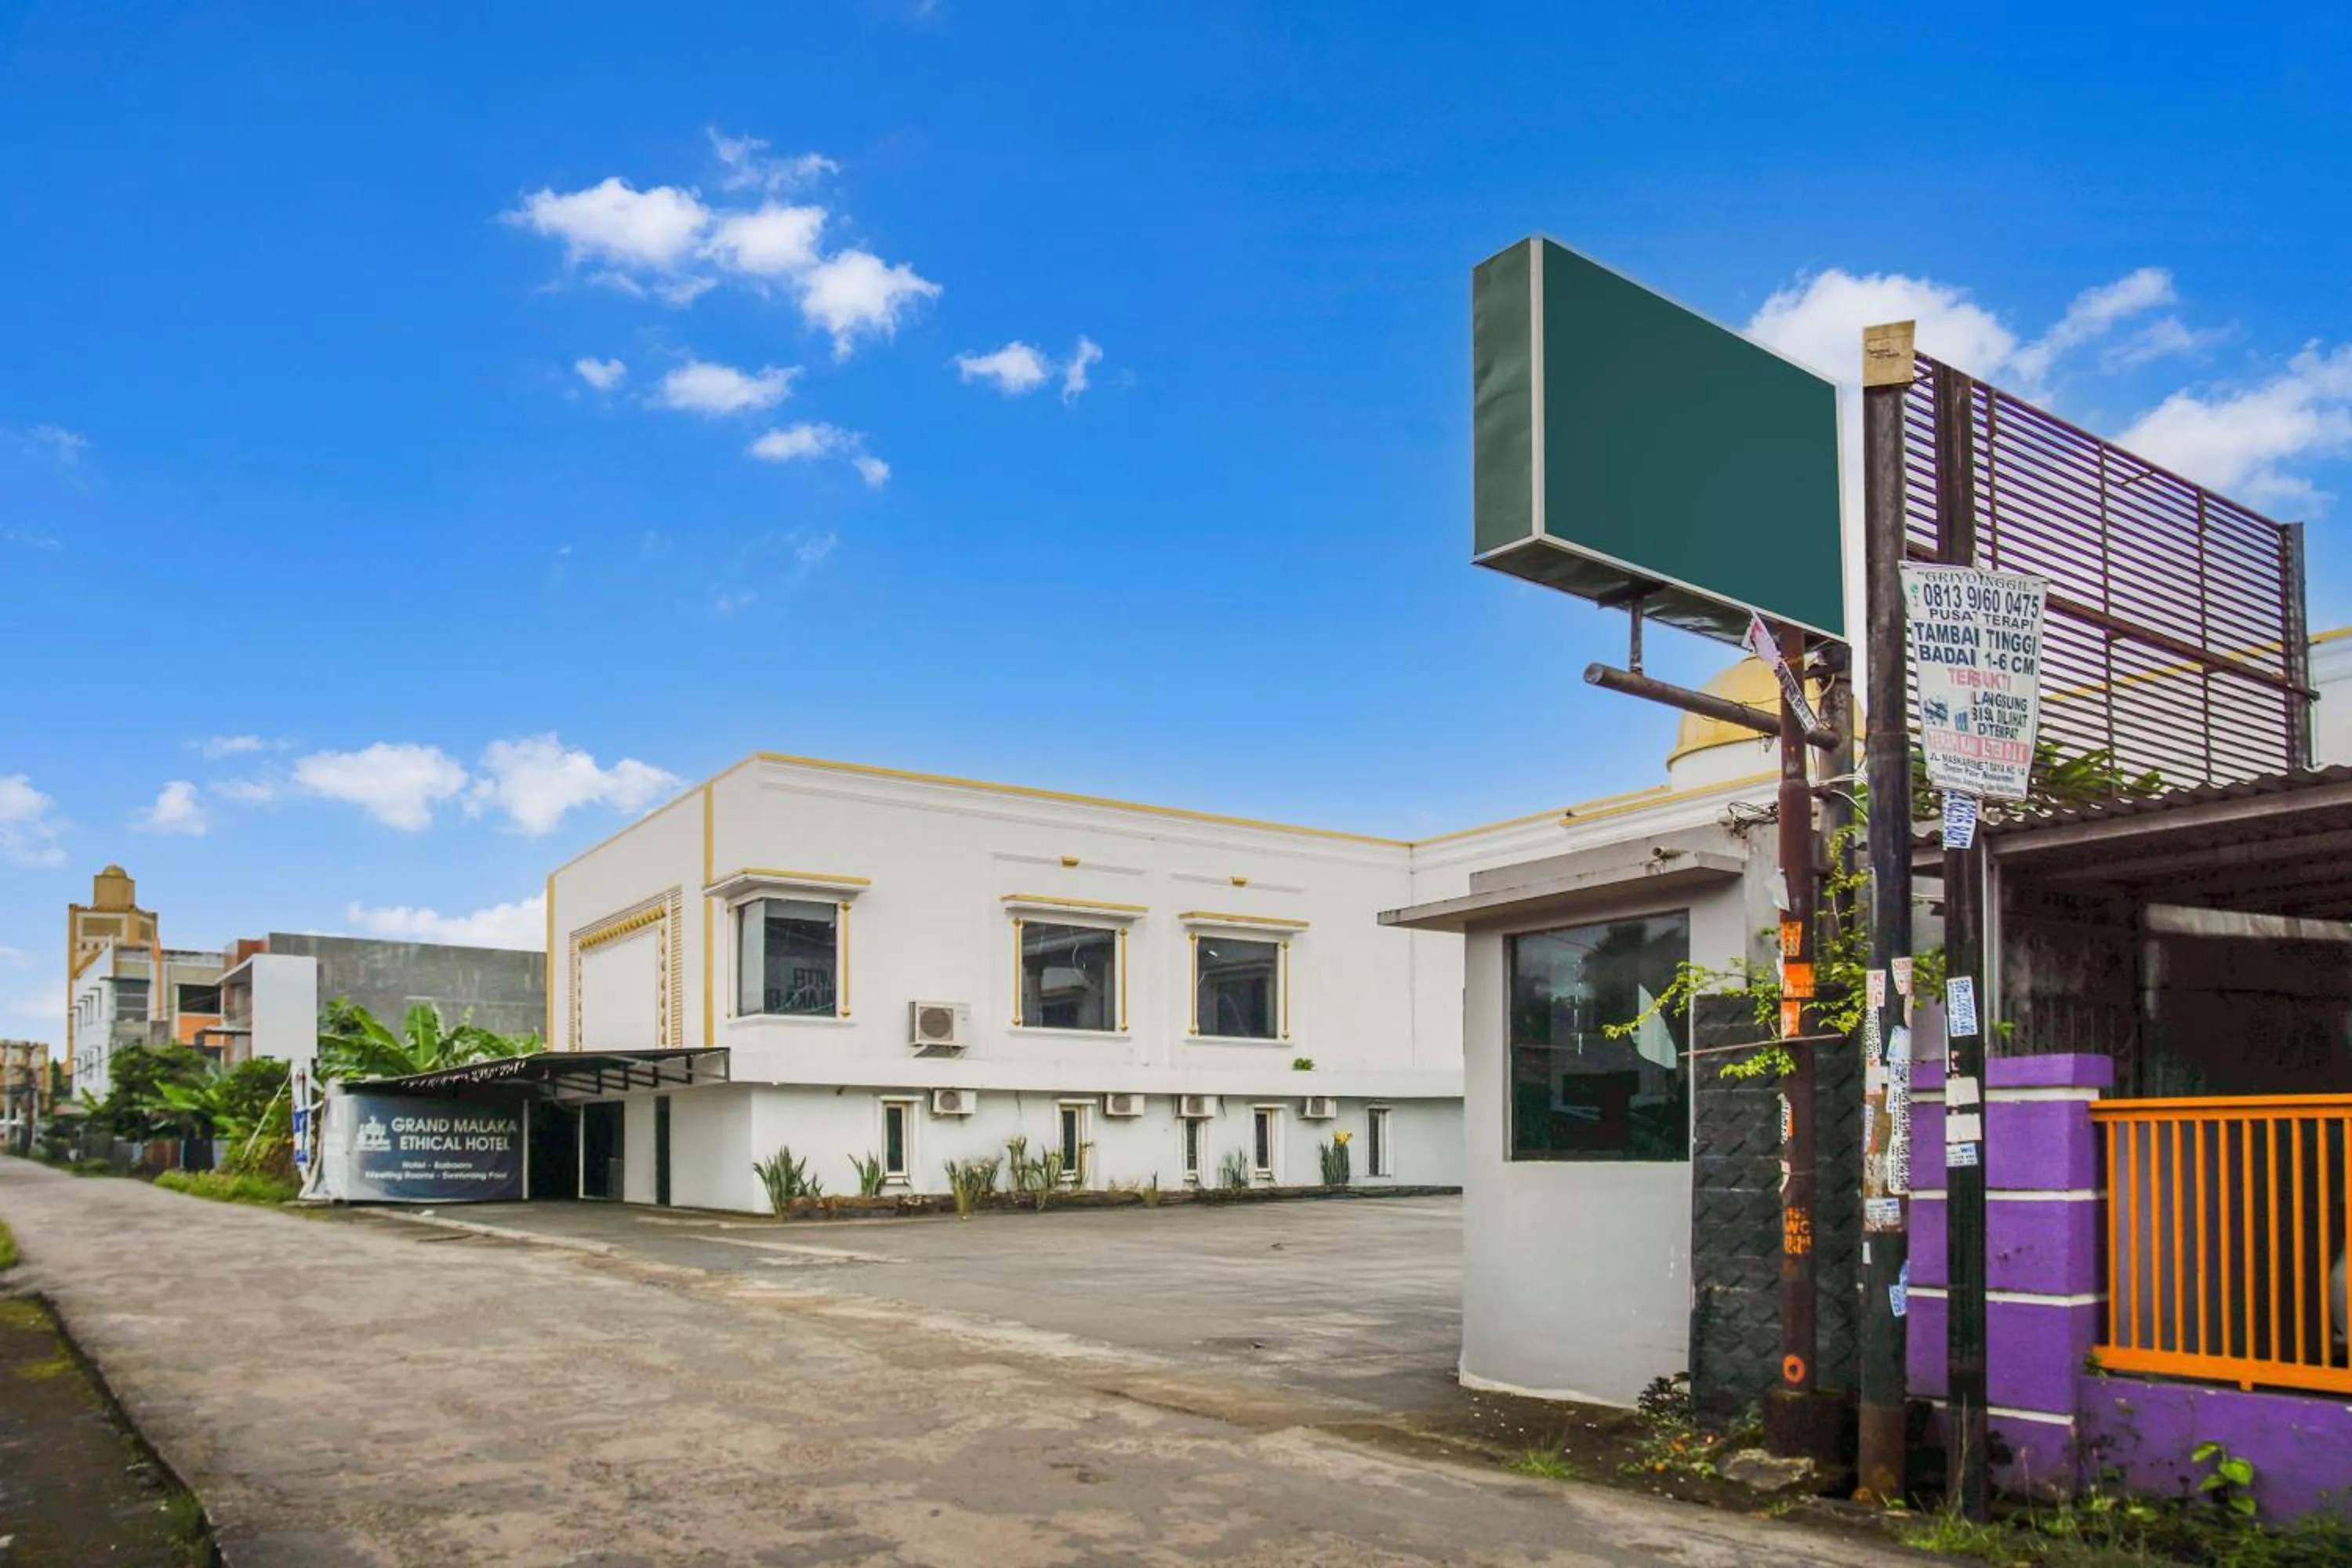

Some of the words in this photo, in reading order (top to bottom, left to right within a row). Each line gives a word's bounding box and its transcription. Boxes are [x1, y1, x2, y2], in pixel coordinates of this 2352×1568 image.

[1923, 583, 1962, 609] 0813
[2005, 590, 2039, 619] 0475
[1983, 612, 2034, 631] TERAPI
[1986, 628, 2037, 656] TINGGI
[2012, 658, 2035, 676] CM
[391, 1116, 449, 1134] GRAND
[454, 1117, 518, 1134] MALAKA
[399, 1134, 462, 1151] ETHICAL
[466, 1134, 510, 1152] HOTEL
